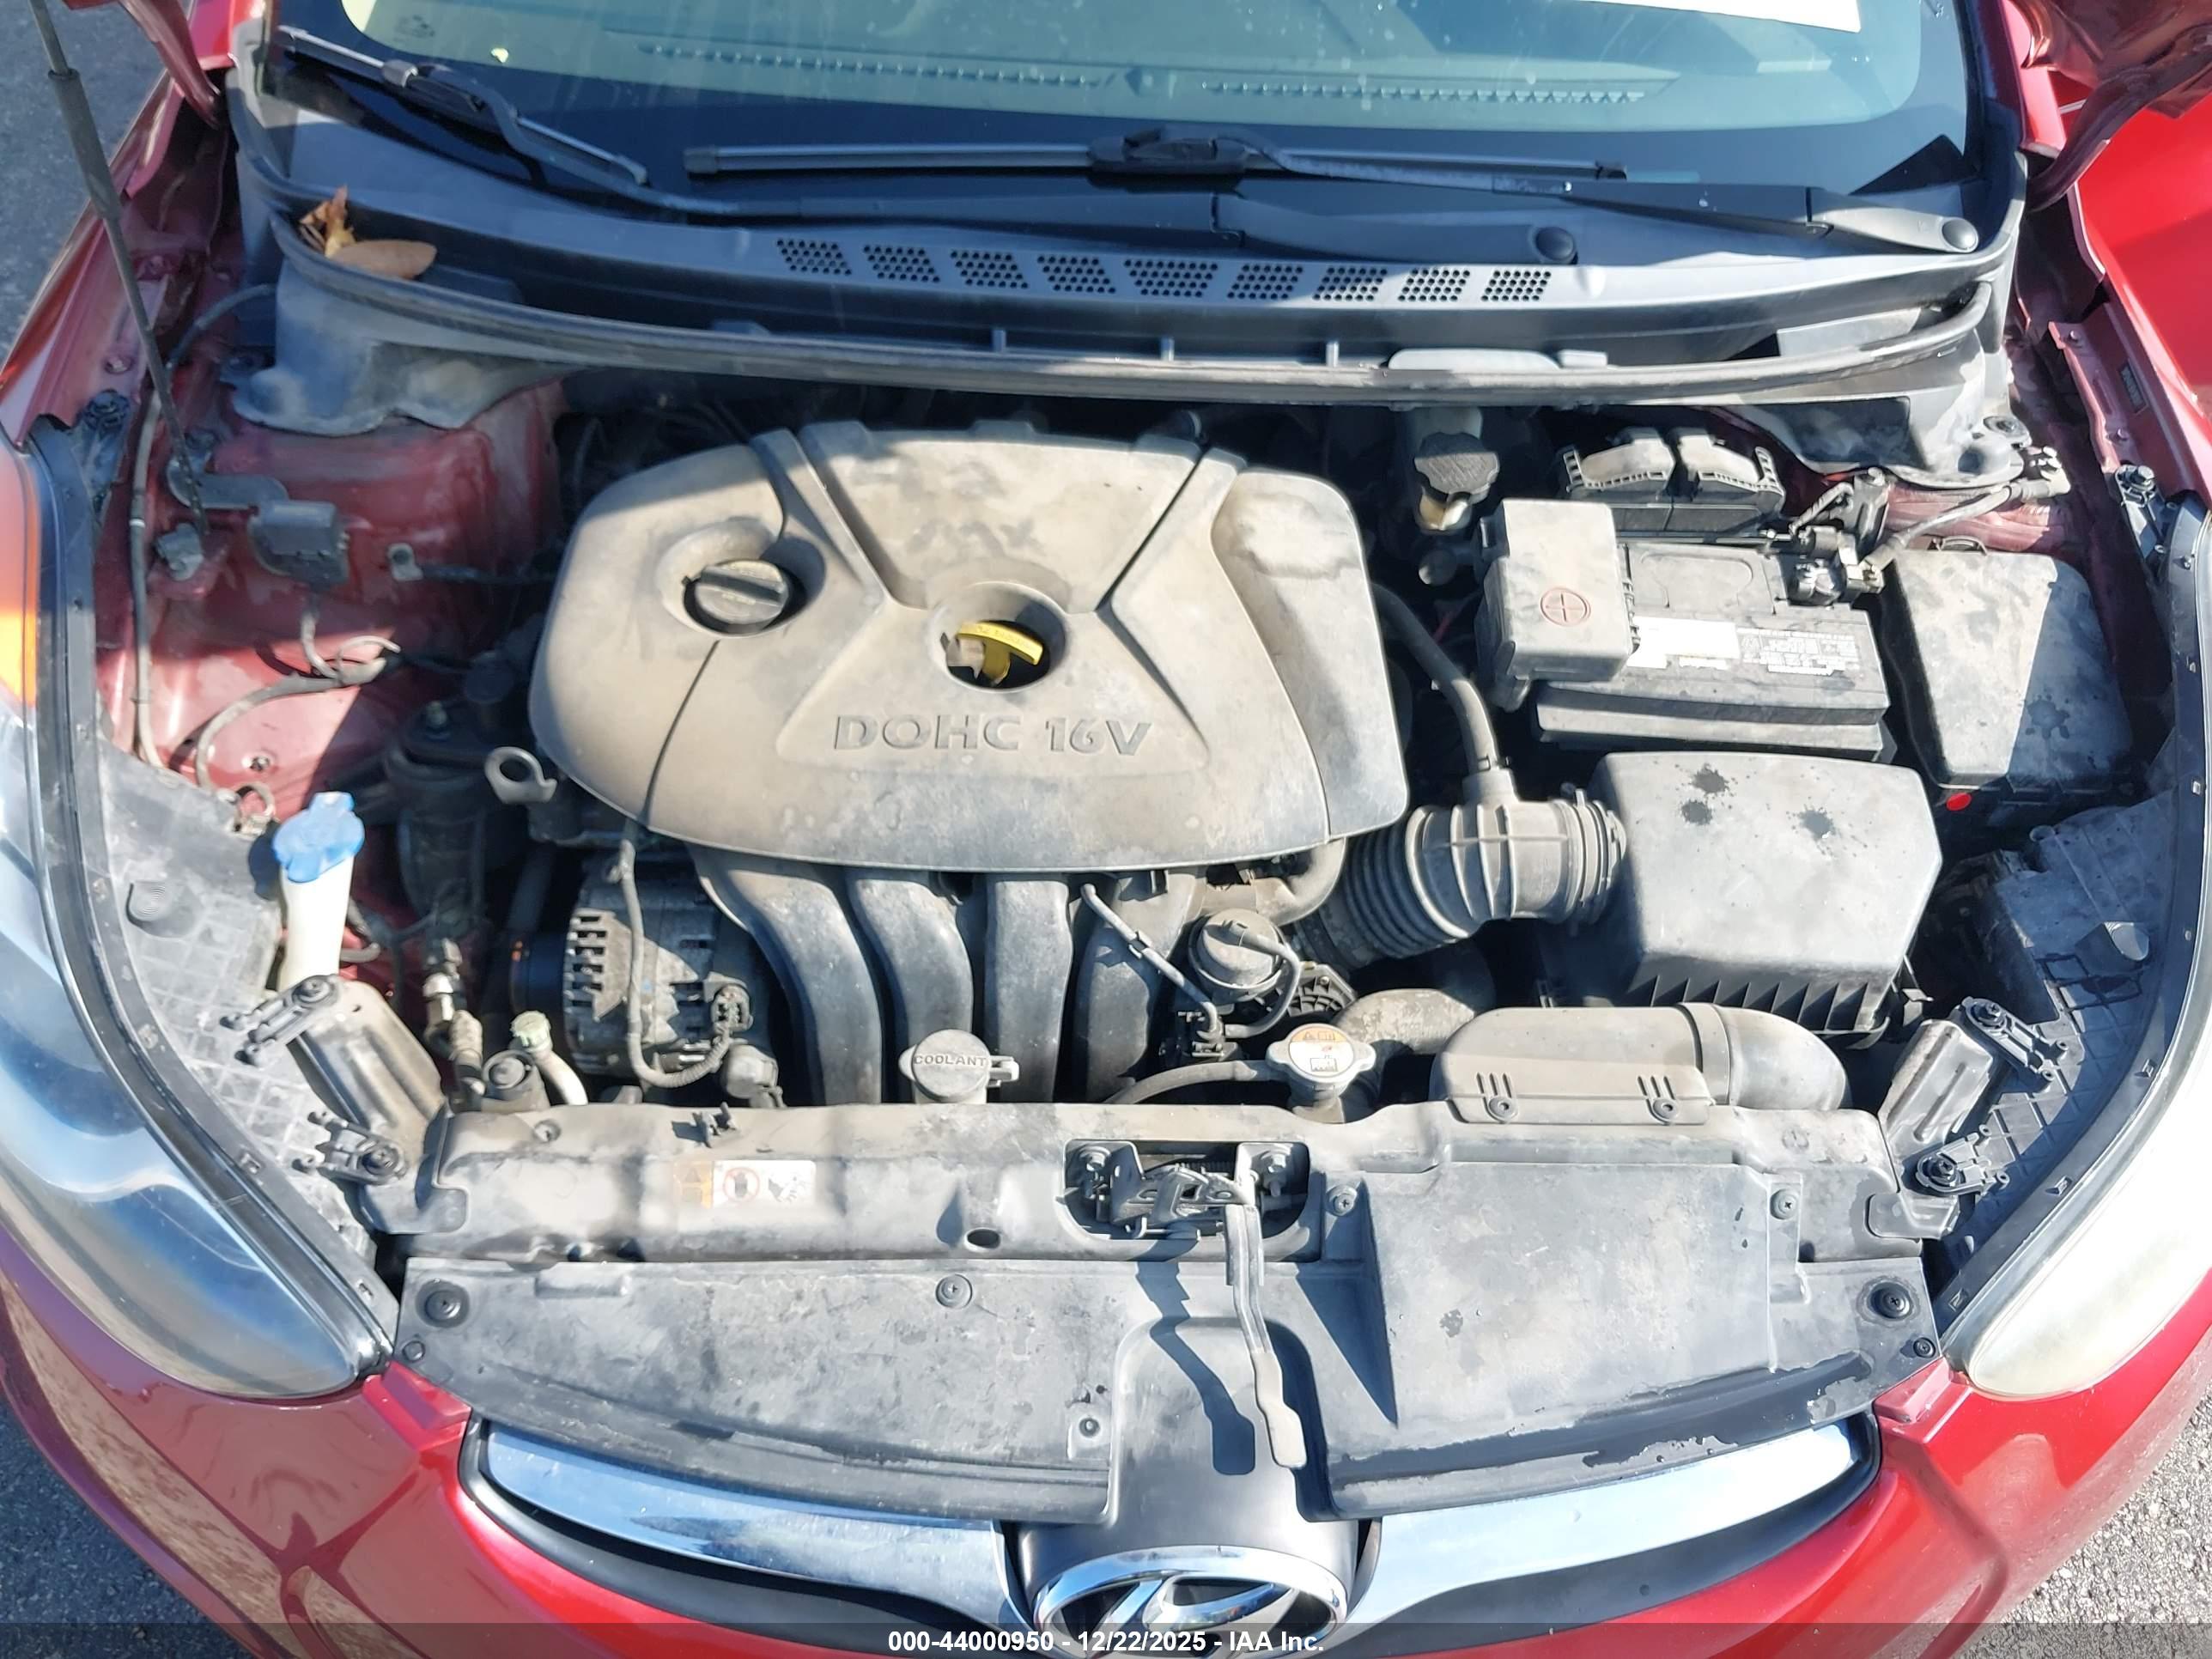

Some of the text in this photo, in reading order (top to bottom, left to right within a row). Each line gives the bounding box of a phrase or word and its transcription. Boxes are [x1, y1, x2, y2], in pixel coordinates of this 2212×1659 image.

[834, 714, 1152, 757] DOHC 16V
[914, 1054, 987, 1066] COOLANT
